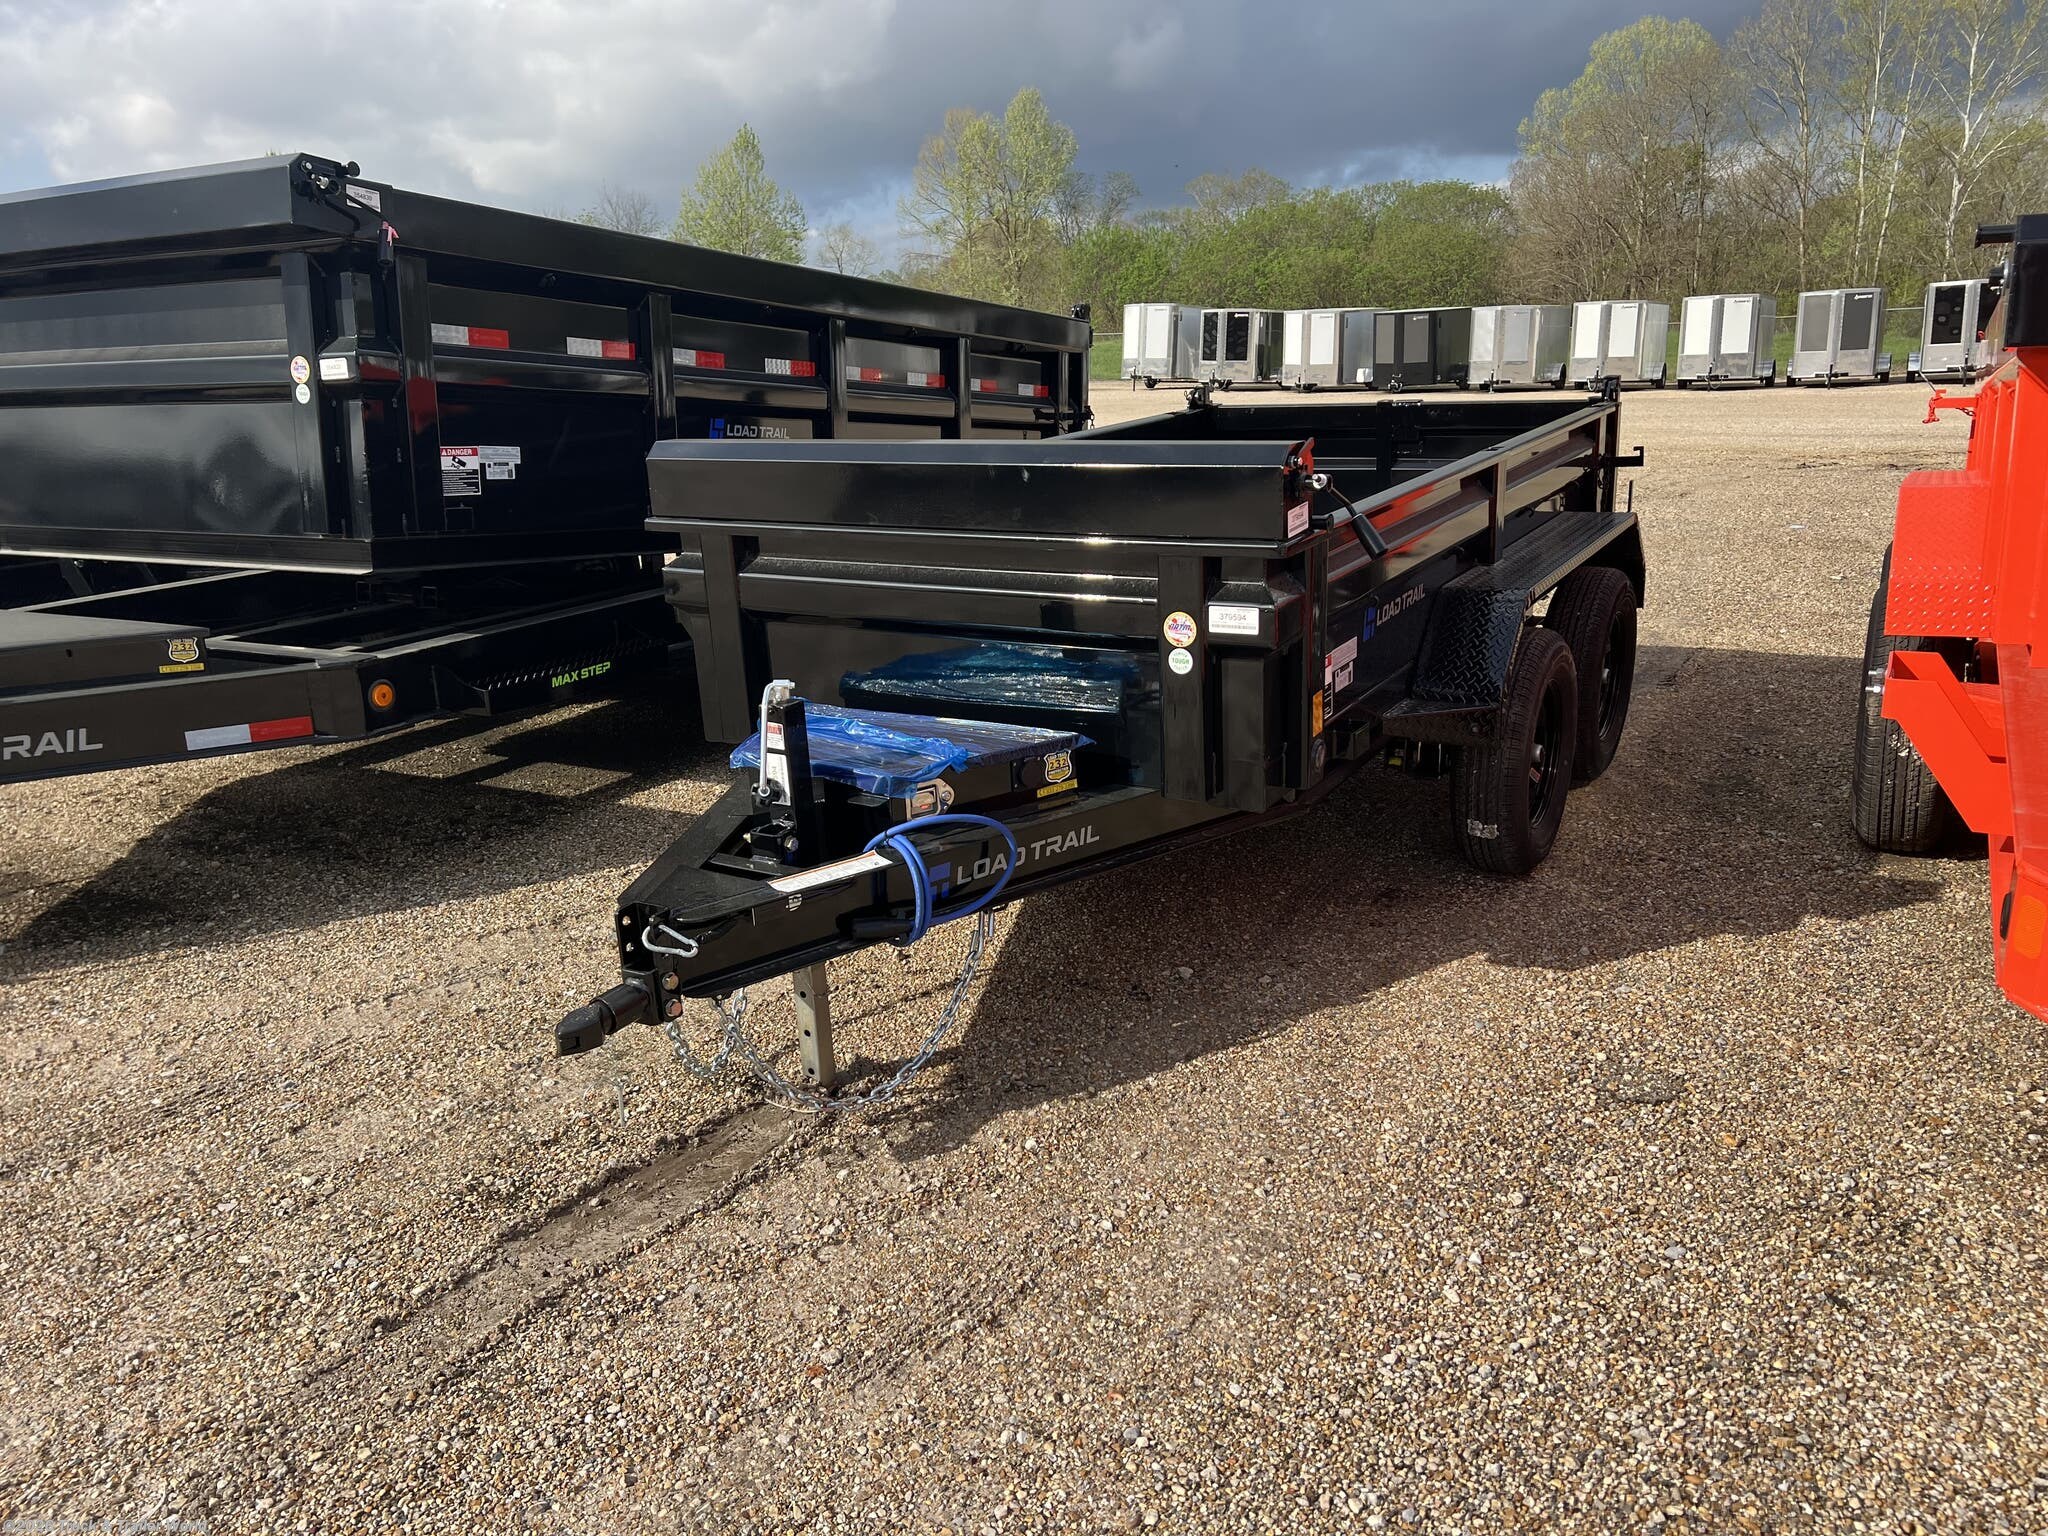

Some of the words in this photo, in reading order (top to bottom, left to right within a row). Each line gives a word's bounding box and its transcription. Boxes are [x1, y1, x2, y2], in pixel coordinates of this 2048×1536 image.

[726, 424, 758, 438] LOAD
[759, 426, 790, 439] TRAIL
[446, 448, 473, 456] DANGER
[1376, 597, 1401, 626] LOAD
[1402, 583, 1426, 611] TRAIL
[551, 670, 579, 688] MAX
[581, 661, 611, 679] STEP
[3, 728, 103, 760] RAIL
[1049, 758, 1068, 770] 232
[957, 847, 1026, 885] LOAD
[1031, 825, 1100, 860] TRAIL
